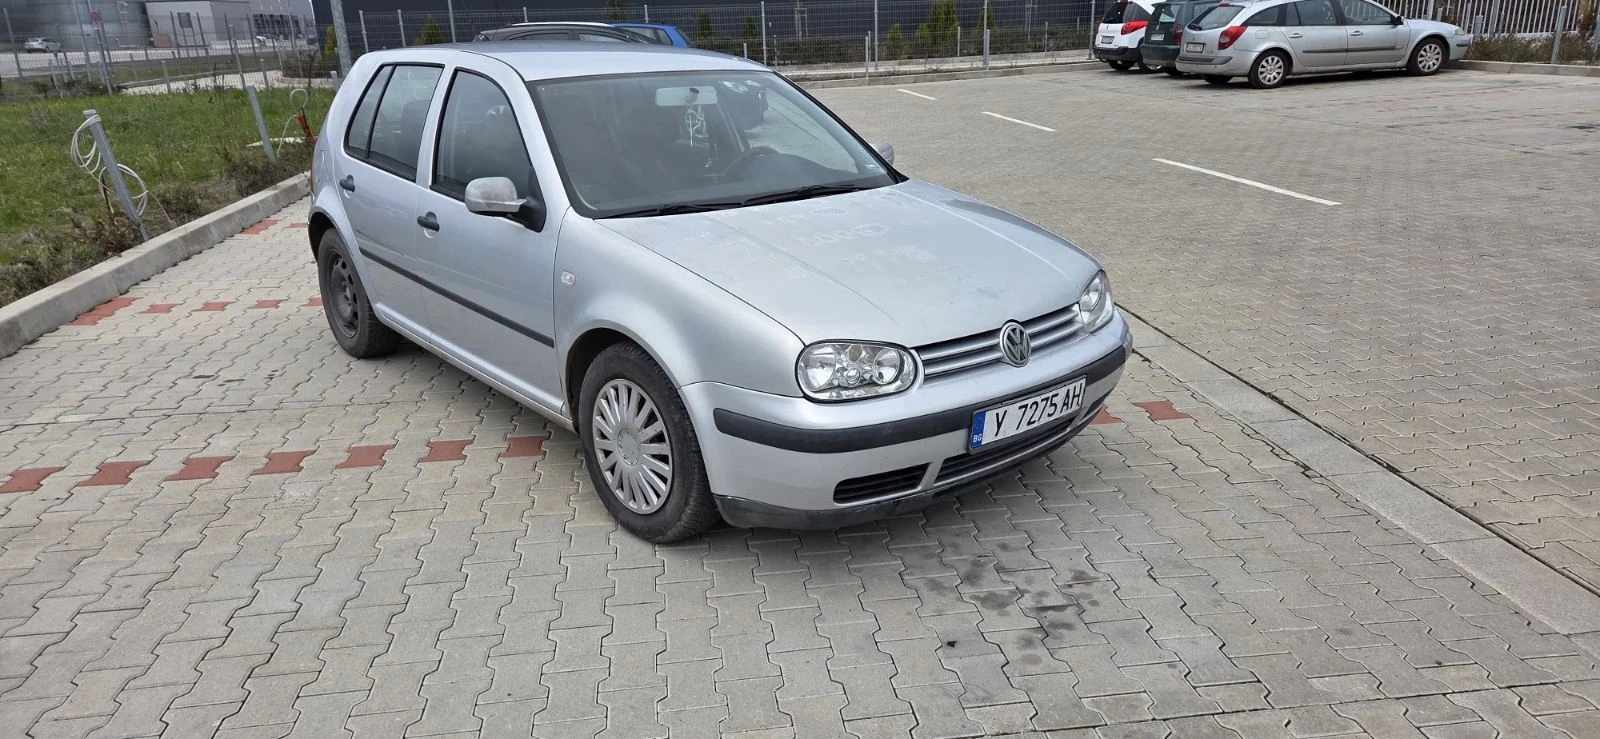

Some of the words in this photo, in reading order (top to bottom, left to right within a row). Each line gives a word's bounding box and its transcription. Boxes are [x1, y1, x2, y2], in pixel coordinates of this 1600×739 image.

[995, 410, 1007, 437] Y
[1016, 393, 1059, 430] 7275
[1060, 383, 1082, 413] AH
[973, 433, 983, 443] BG
